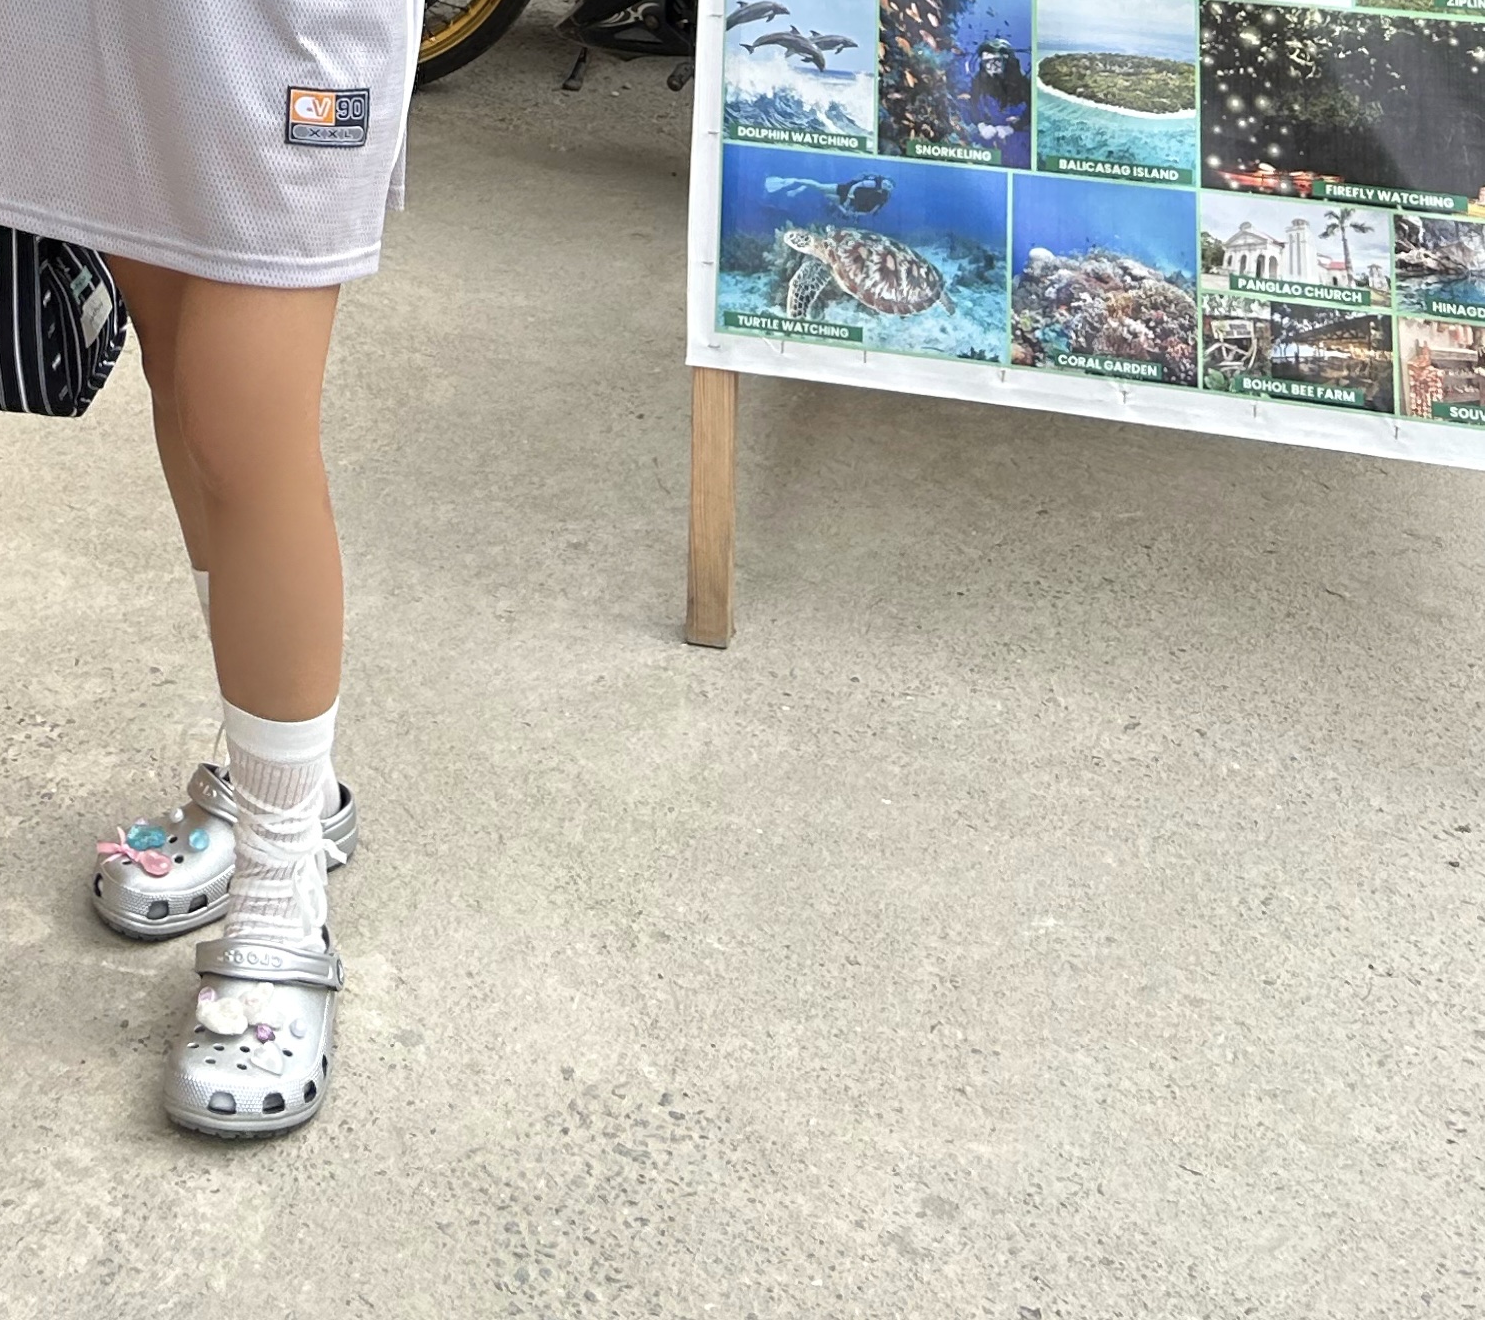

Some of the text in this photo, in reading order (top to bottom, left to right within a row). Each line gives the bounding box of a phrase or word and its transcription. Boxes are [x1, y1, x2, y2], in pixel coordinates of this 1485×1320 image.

[335, 97, 366, 122] 90
[737, 126, 859, 149] DOLPHIN WATCHING
[914, 143, 993, 162] SNORKELING
[1058, 158, 1179, 181] BALICASAG ISLAND
[1325, 183, 1455, 209] FIREFLY WATCHING
[1237, 277, 1363, 303] PANGLAO CHURCH
[737, 314, 850, 338] TURTLE WATCHING
[1057, 354, 1158, 377] CORAL GARDEN
[1242, 377, 1356, 403] BOHOL BEE FARM
